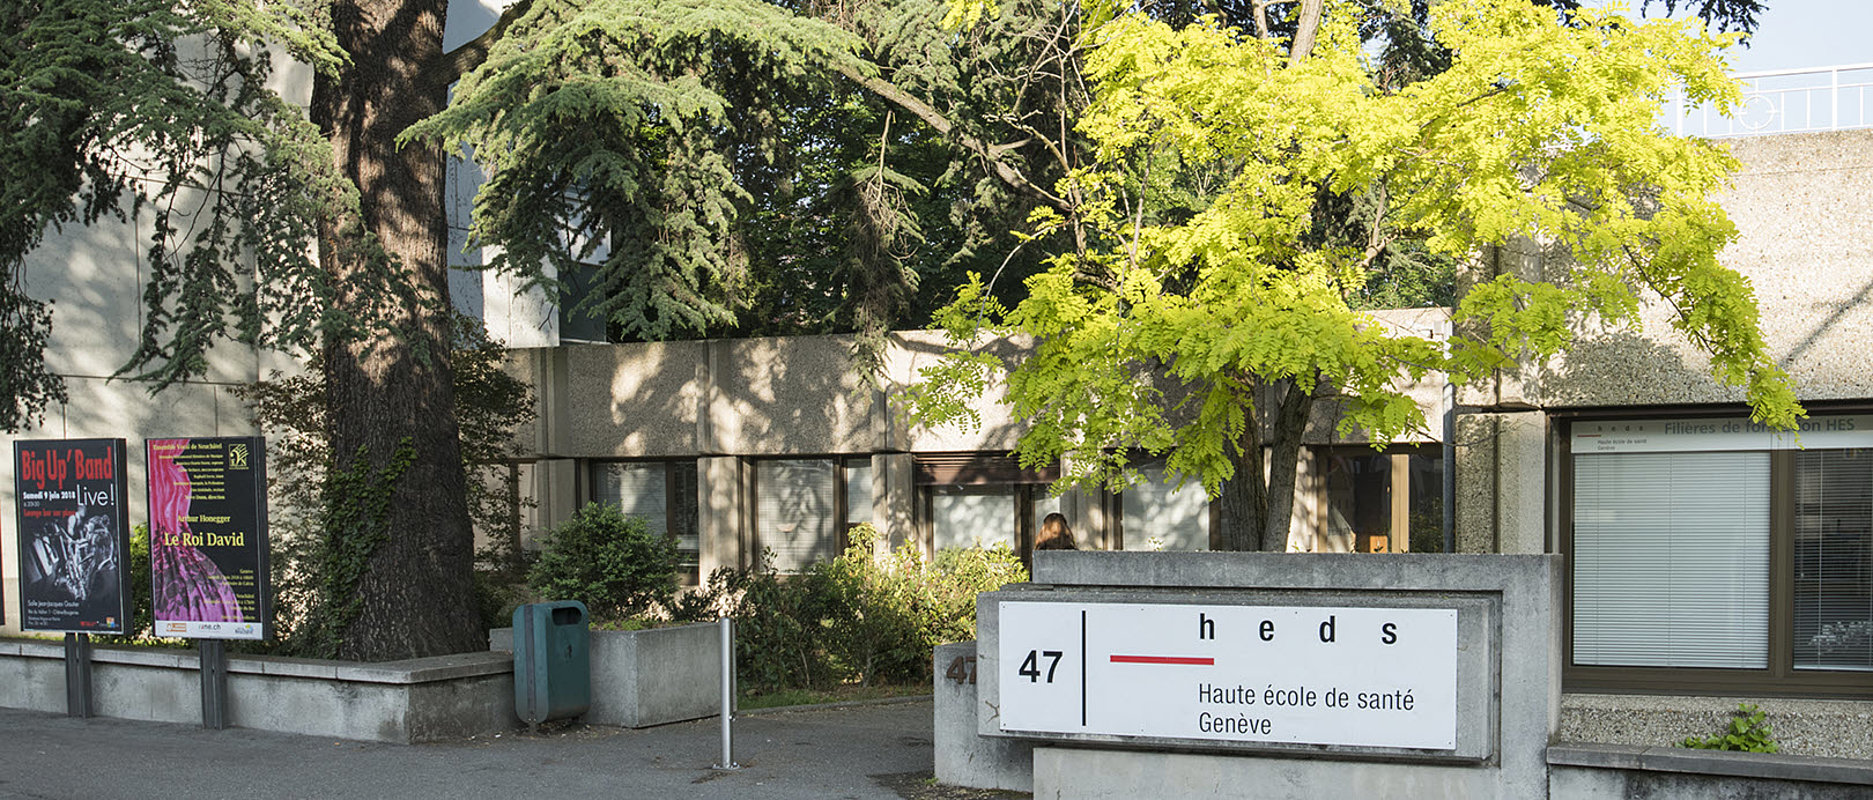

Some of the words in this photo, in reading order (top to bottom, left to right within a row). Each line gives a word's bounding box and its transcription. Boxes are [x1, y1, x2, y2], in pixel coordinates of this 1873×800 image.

[1665, 422, 1716, 435] Filières
[1722, 420, 1741, 433] de
[1746, 419, 1821, 433] foron
[1826, 418, 1855, 431] HES
[22, 450, 45, 490] Big
[75, 446, 112, 480] Band
[23, 491, 43, 499] Samedi
[76, 484, 114, 506] Live!
[200, 515, 231, 524] Honegger
[164, 532, 180, 546] Le
[183, 532, 204, 546] Roi
[207, 532, 245, 546] David
[1018, 650, 1063, 683] 47
[1199, 683, 1256, 704] Haute
[1264, 684, 1317, 707] école
[1325, 688, 1349, 708] de
[1357, 689, 1414, 710] santé
[1199, 712, 1272, 735] Genève
